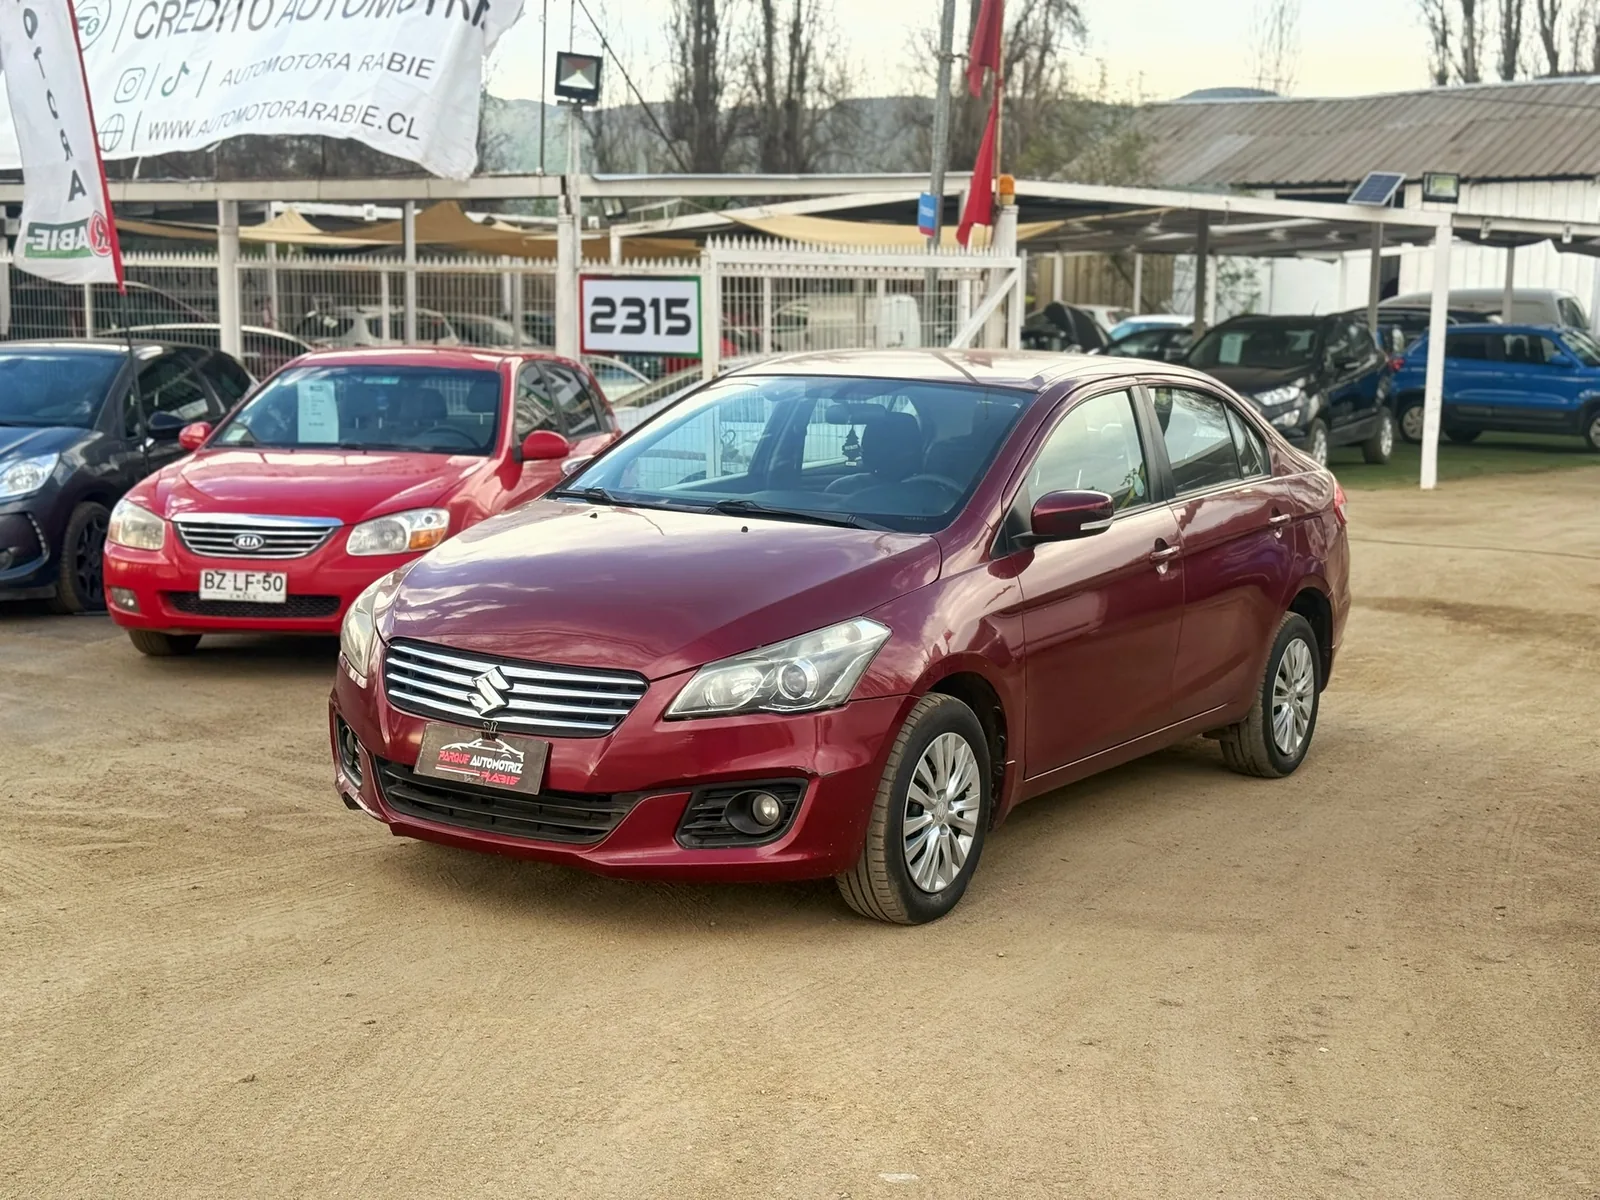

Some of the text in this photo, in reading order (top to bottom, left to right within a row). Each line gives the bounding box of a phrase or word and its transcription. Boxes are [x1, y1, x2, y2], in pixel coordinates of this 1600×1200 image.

[219, 52, 435, 86] AUTOMOTORA RABIE
[148, 100, 420, 141] WWW.AUTOMOTORARABIE.CL
[590, 297, 692, 336] 2315
[238, 537, 259, 547] KIA
[438, 750, 524, 774] PARQUE AUTOMOTRIZ
